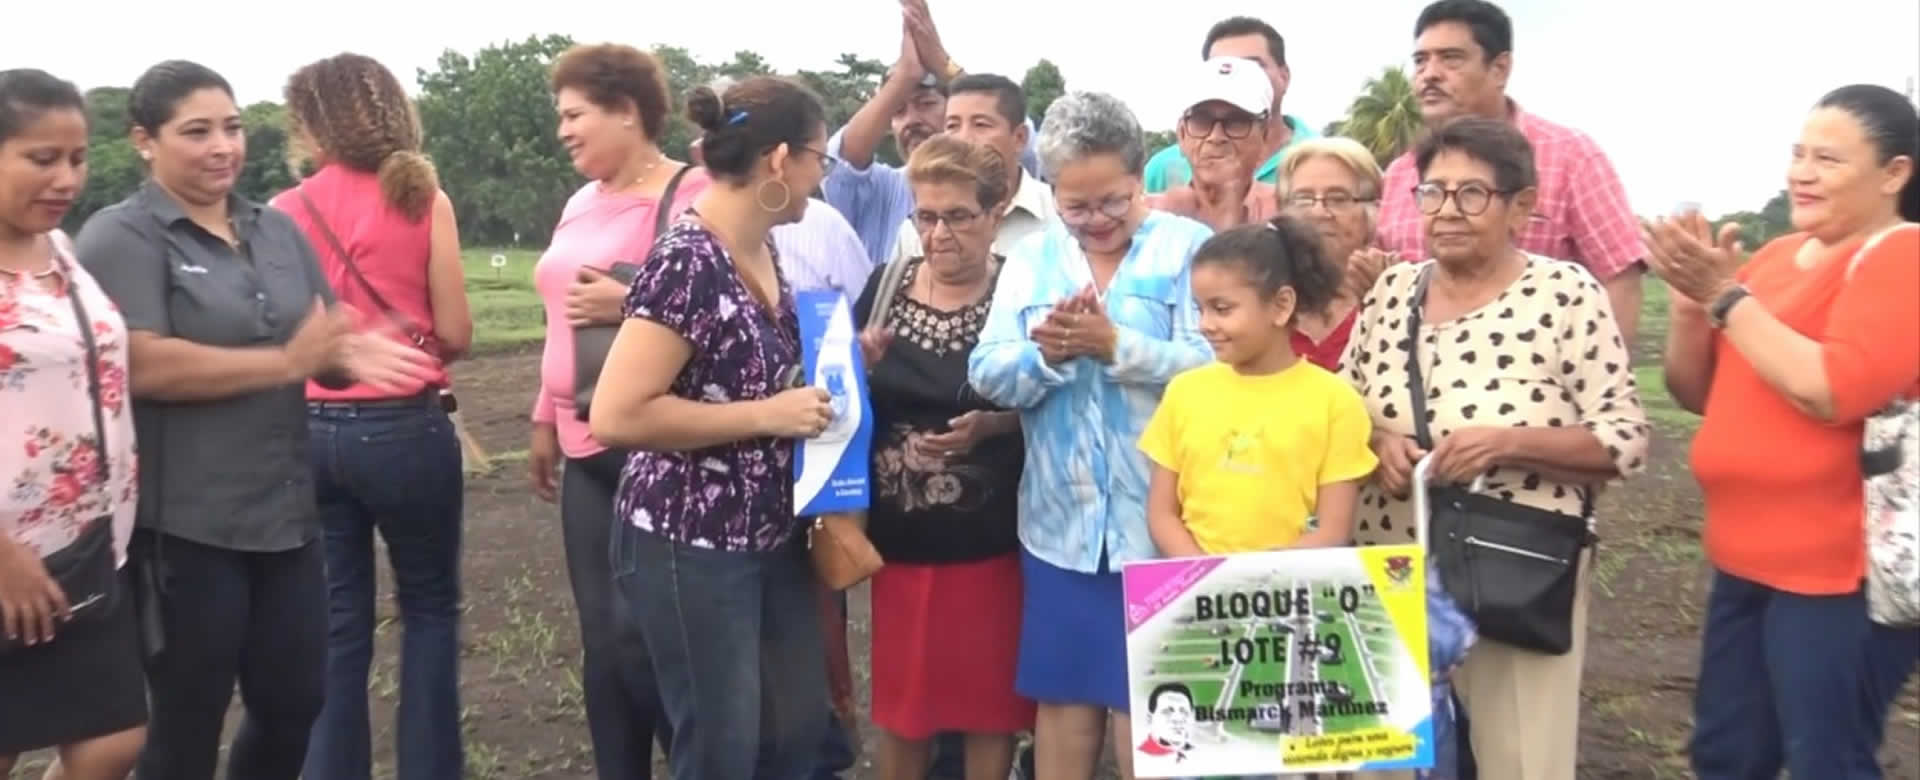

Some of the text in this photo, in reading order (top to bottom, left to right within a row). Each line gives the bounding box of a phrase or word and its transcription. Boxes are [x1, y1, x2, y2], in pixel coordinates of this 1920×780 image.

[1196, 587, 1310, 621] BLOQUE
[1220, 638, 1286, 665] LOTE
[1240, 680, 1338, 700] Programa
[1194, 704, 1291, 724] Bismarck
